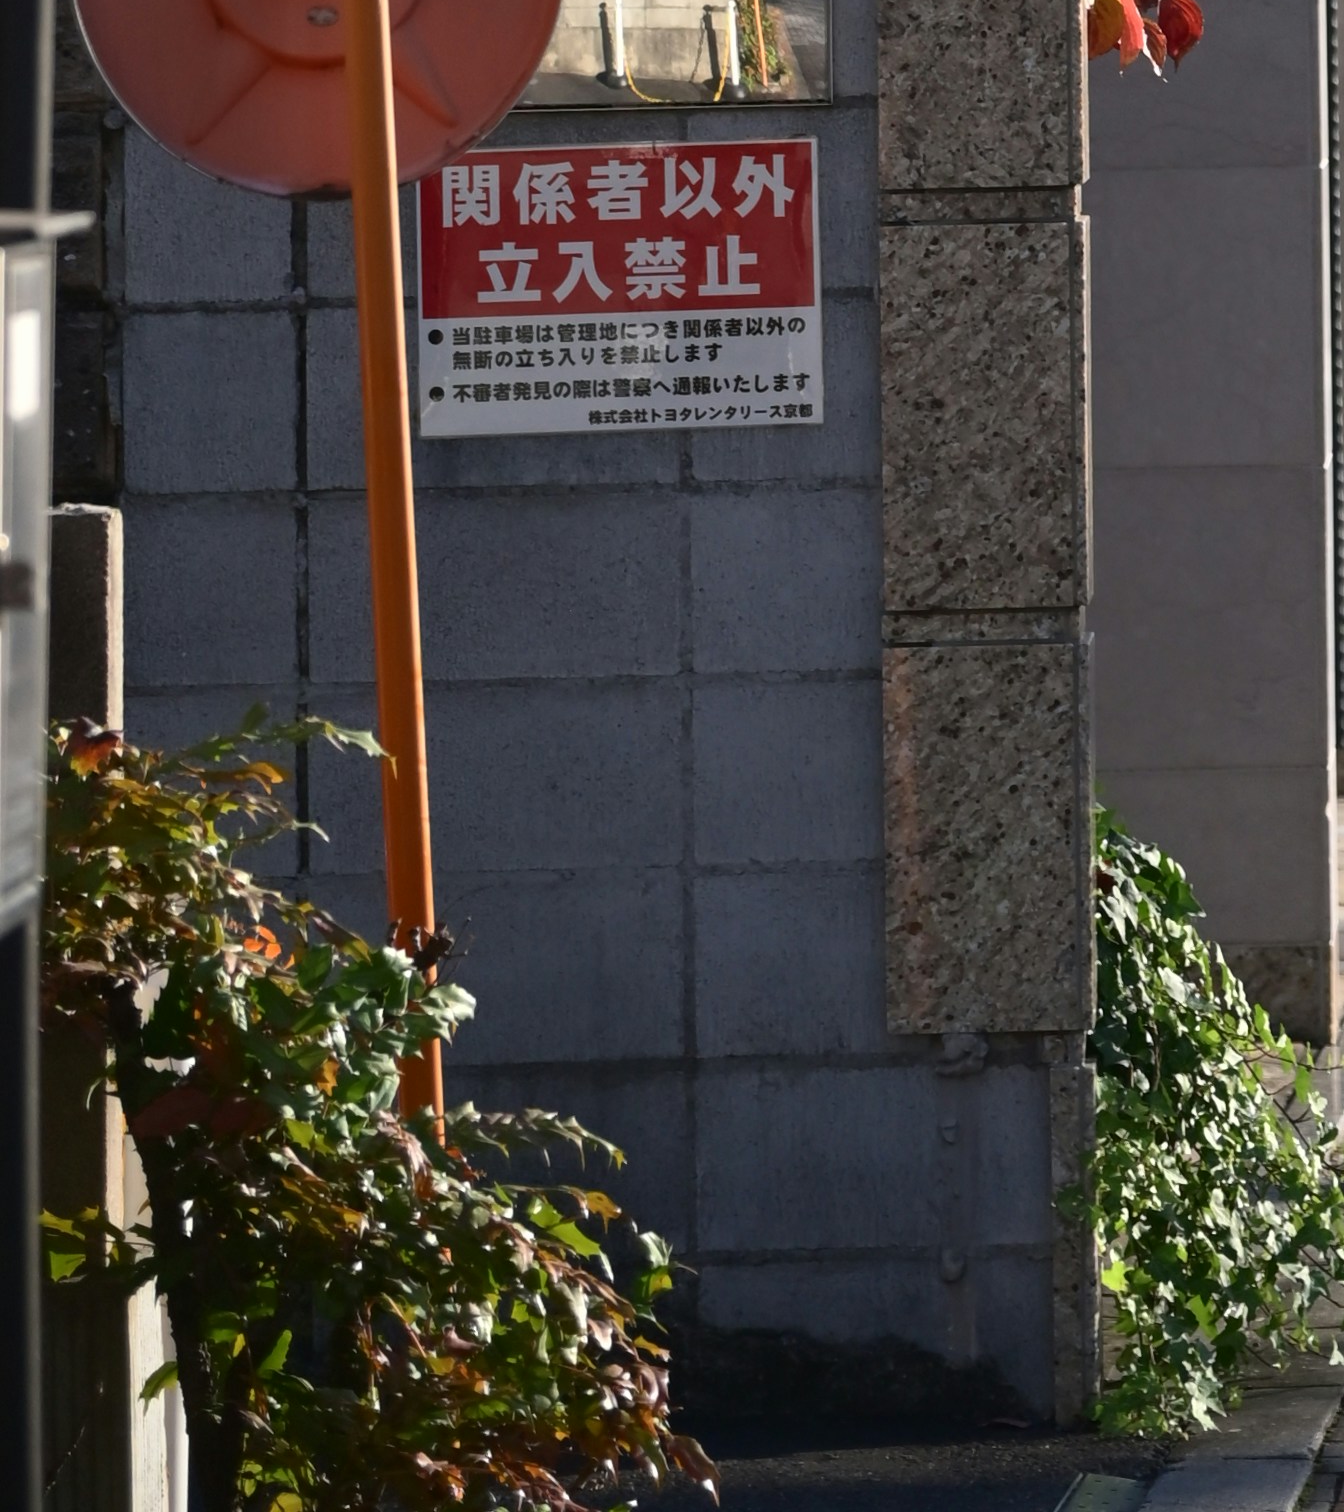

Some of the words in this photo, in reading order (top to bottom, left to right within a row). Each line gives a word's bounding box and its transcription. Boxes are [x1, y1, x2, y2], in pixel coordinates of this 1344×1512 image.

[442, 154, 795, 227] 関係者以外
[477, 235, 760, 304] 立入禁止
[452, 317, 806, 346] 当駐車場は管理地につき関係者以外の
[452, 343, 723, 370] 無断の立ち入りを禁止します
[452, 373, 810, 403] 不審者発見の際は警察へ通報いたします
[588, 403, 813, 425] 株式会社トヨタレンタリース京都
